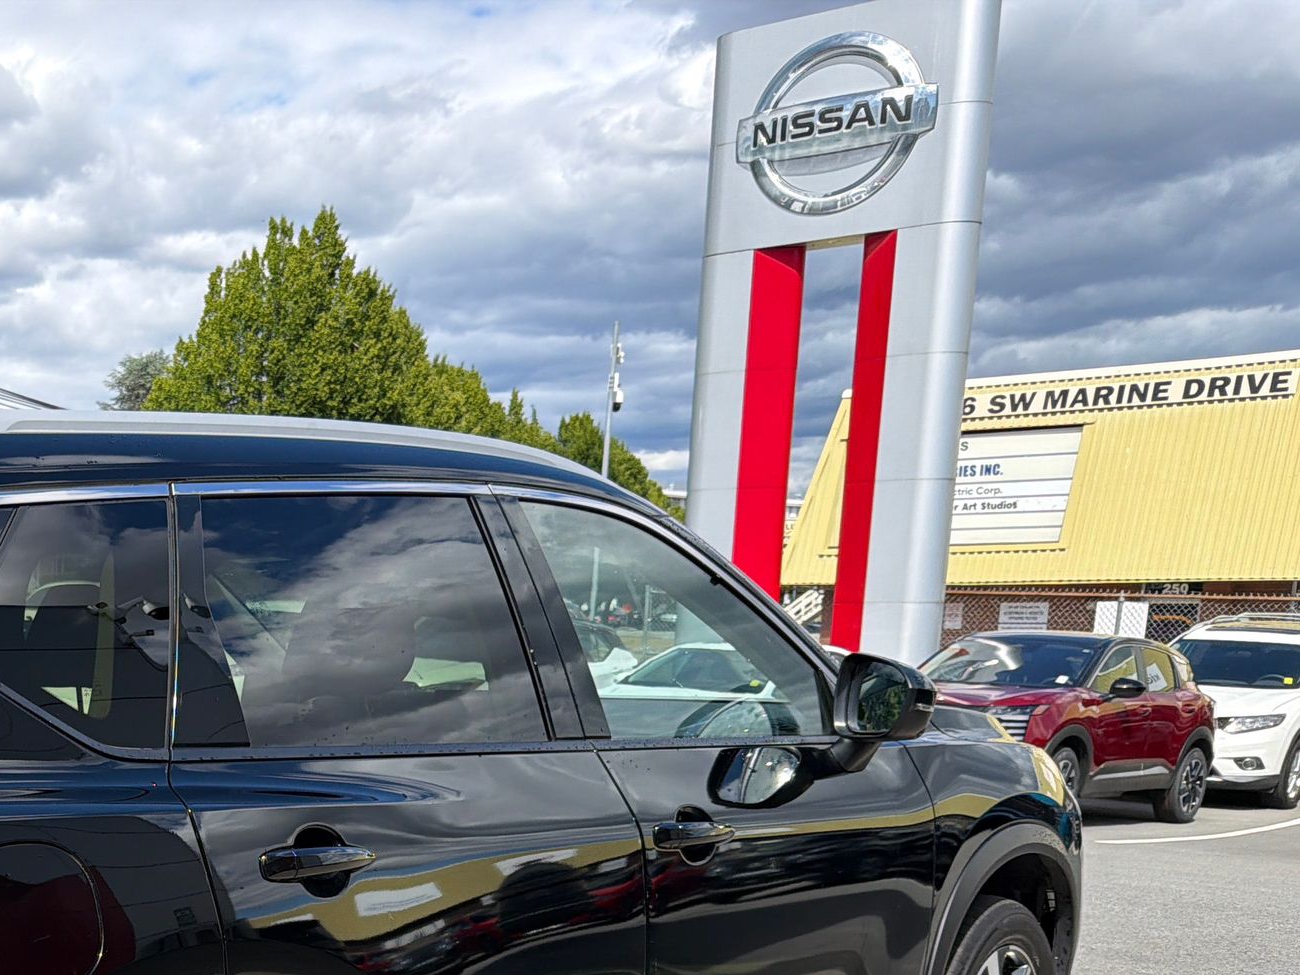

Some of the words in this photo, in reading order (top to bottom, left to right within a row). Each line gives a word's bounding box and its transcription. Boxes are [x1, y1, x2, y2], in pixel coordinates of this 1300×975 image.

[752, 94, 914, 148] NISSAN
[987, 391, 1037, 414] SW
[1042, 380, 1172, 410] MARINE
[1181, 371, 1293, 400] DRIVE
[956, 465, 977, 477] IES
[979, 463, 1003, 476] INC.
[975, 486, 1003, 496] Corp.
[961, 502, 977, 511] Art
[980, 500, 1018, 511] Studios
